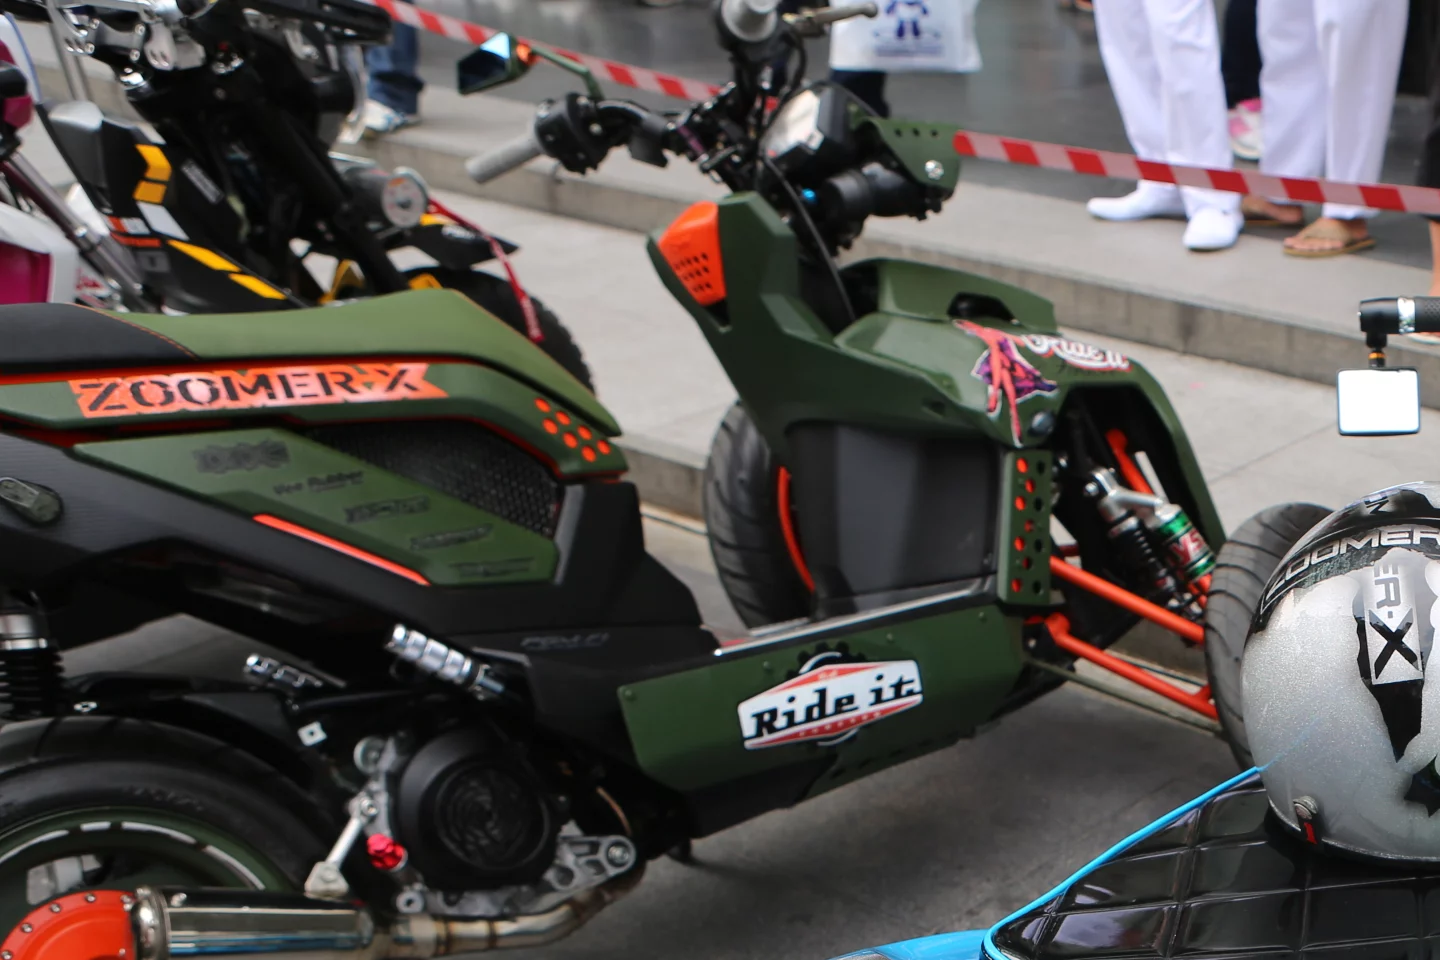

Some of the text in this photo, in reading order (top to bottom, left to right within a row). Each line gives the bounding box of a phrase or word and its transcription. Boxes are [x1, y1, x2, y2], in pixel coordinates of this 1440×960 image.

[80, 367, 420, 413] ZOOMER-X
[743, 685, 860, 741] Ride
[868, 673, 924, 707] it
